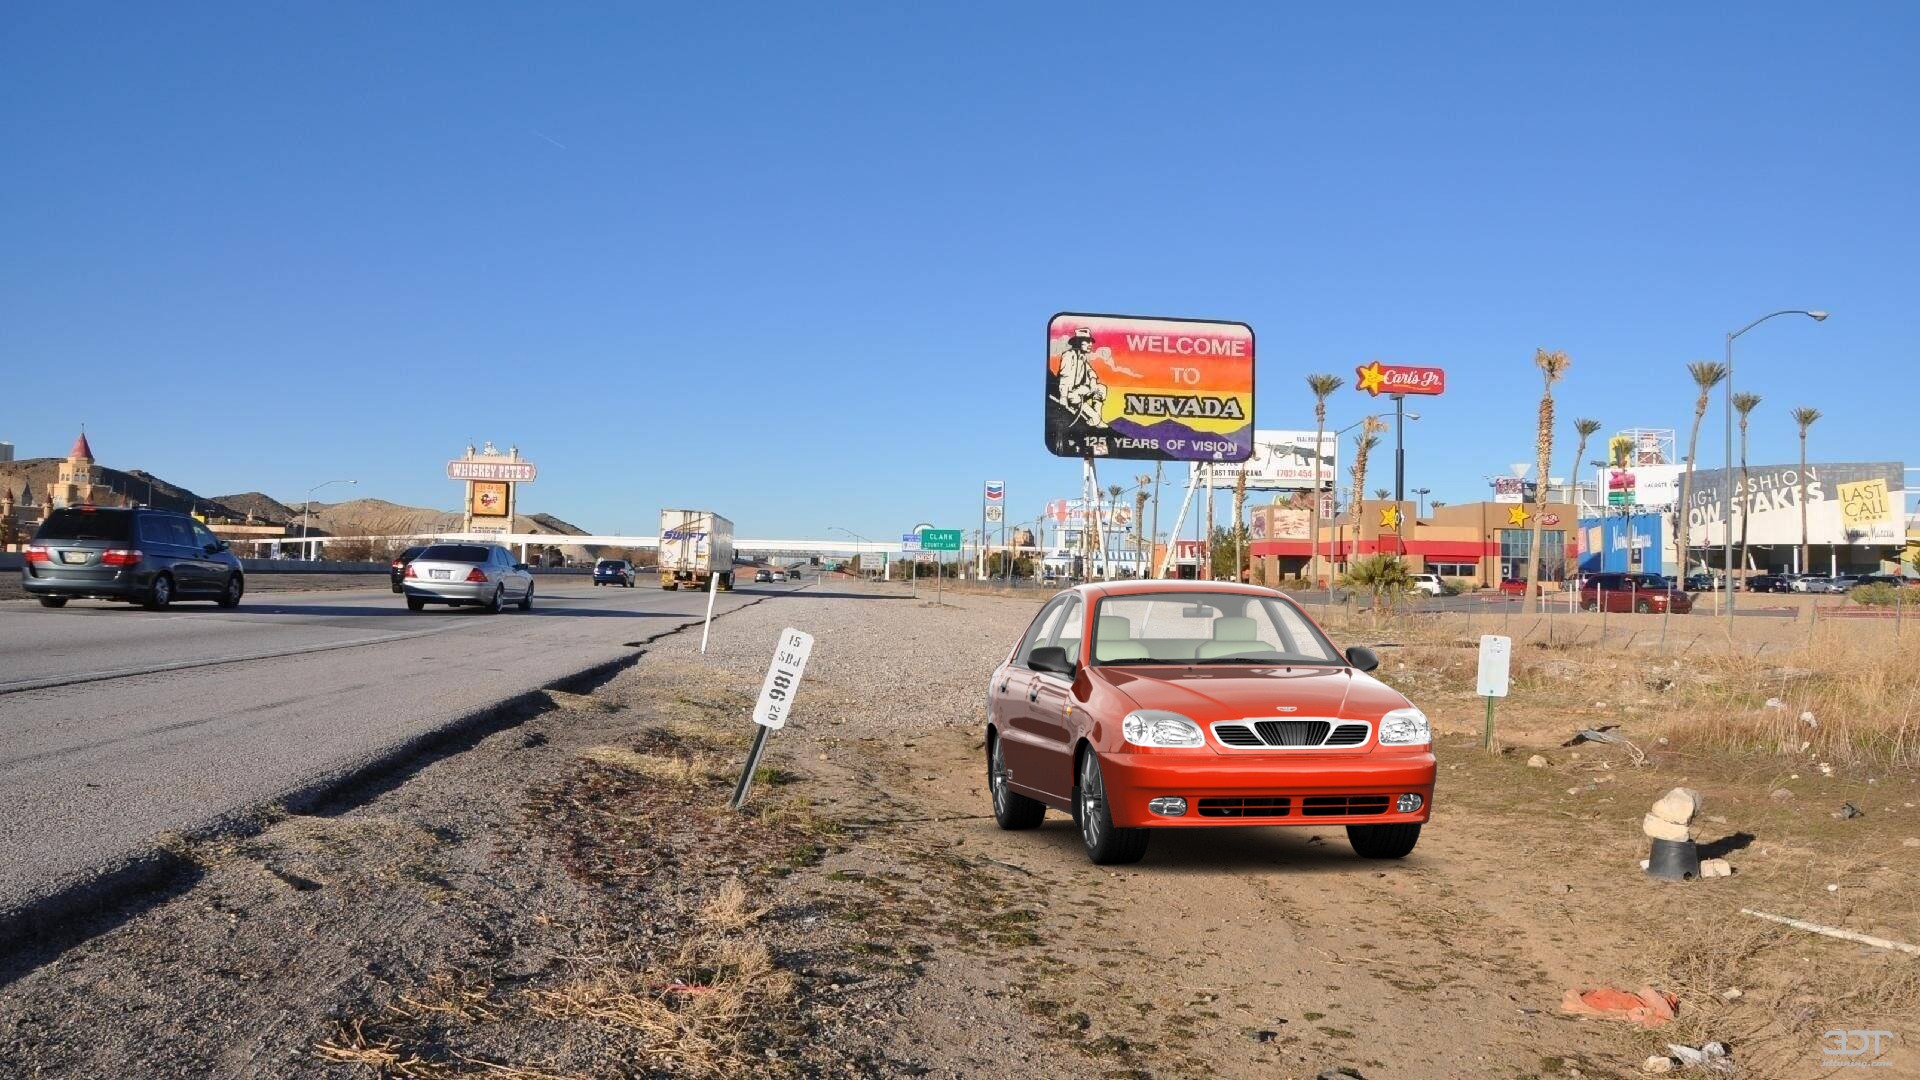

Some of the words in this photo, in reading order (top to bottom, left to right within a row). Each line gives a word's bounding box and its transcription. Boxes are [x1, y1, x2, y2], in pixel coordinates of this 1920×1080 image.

[1126, 334, 1246, 357] WELCOME
[1170, 367, 1200, 384] TO
[1383, 369, 1420, 385] Carl's
[1124, 393, 1244, 420] NEVADA
[1083, 436, 1107, 447] 125
[1114, 437, 1159, 449] YEARS
[1166, 439, 1186, 450] OF
[1191, 440, 1238, 453] VISION
[452, 463, 496, 478] WHISKEY
[498, 464, 530, 479] PETE'S
[1841, 483, 1882, 503] LAST
[1844, 500, 1888, 517] CALL
[663, 530, 708, 541] SWIFT
[789, 634, 802, 648] 15
[769, 669, 794, 701] 186
[767, 704, 781, 721] 20
